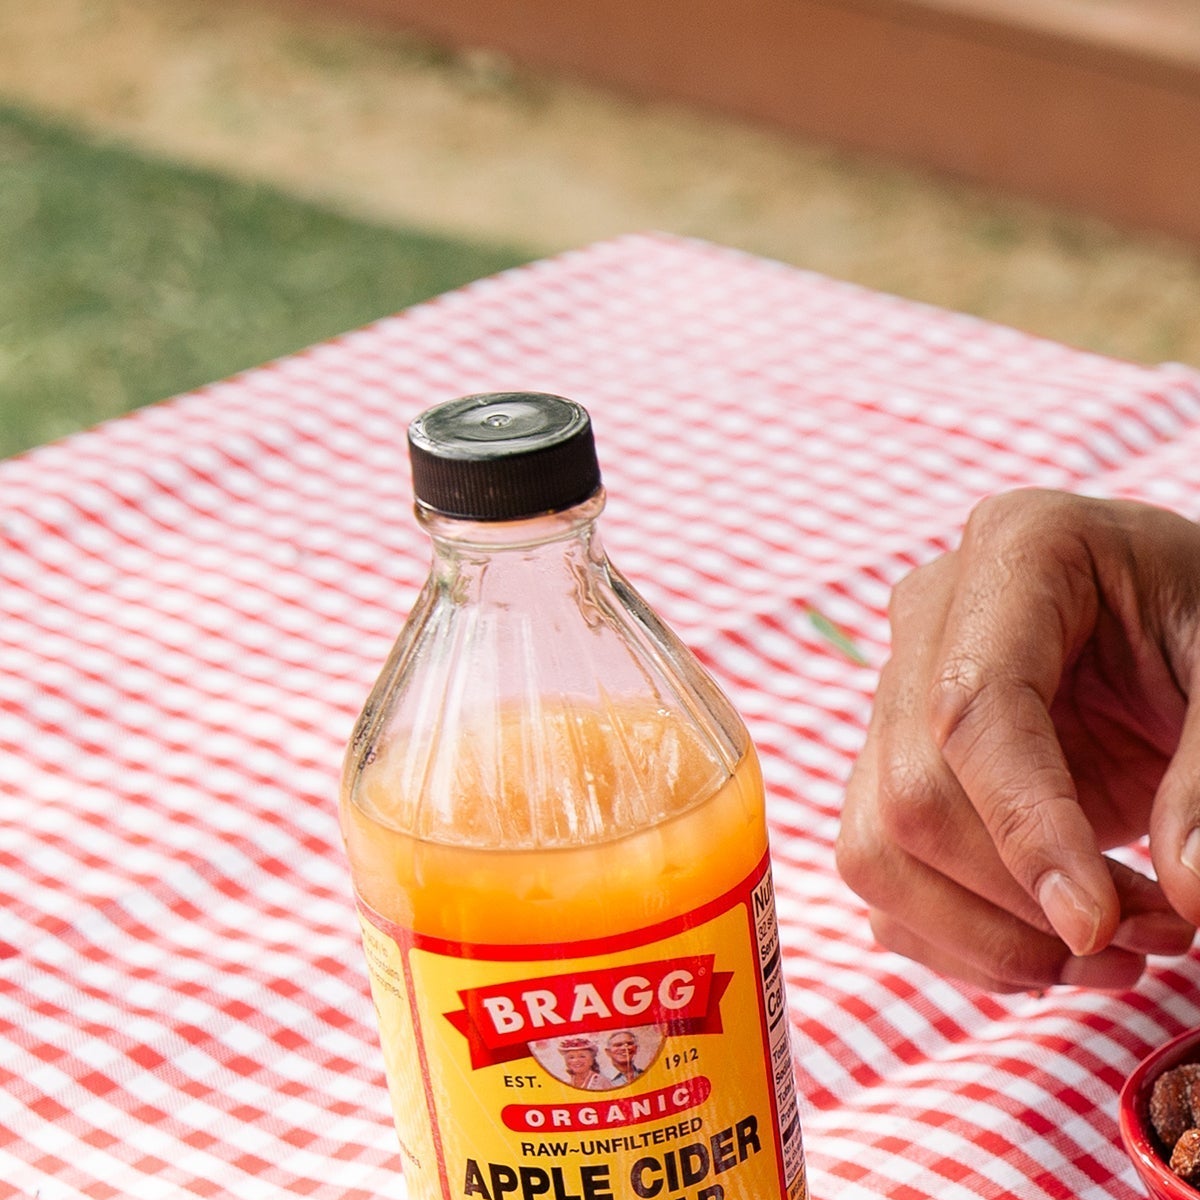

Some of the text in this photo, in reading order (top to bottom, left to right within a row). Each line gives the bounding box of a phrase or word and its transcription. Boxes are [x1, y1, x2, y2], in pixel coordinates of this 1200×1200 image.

[483, 969, 695, 1035] BRAGG
[504, 1047, 699, 1088] EST. 1912
[525, 1086, 690, 1127] ORGANIC
[630, 1115, 761, 1199] CIDER
